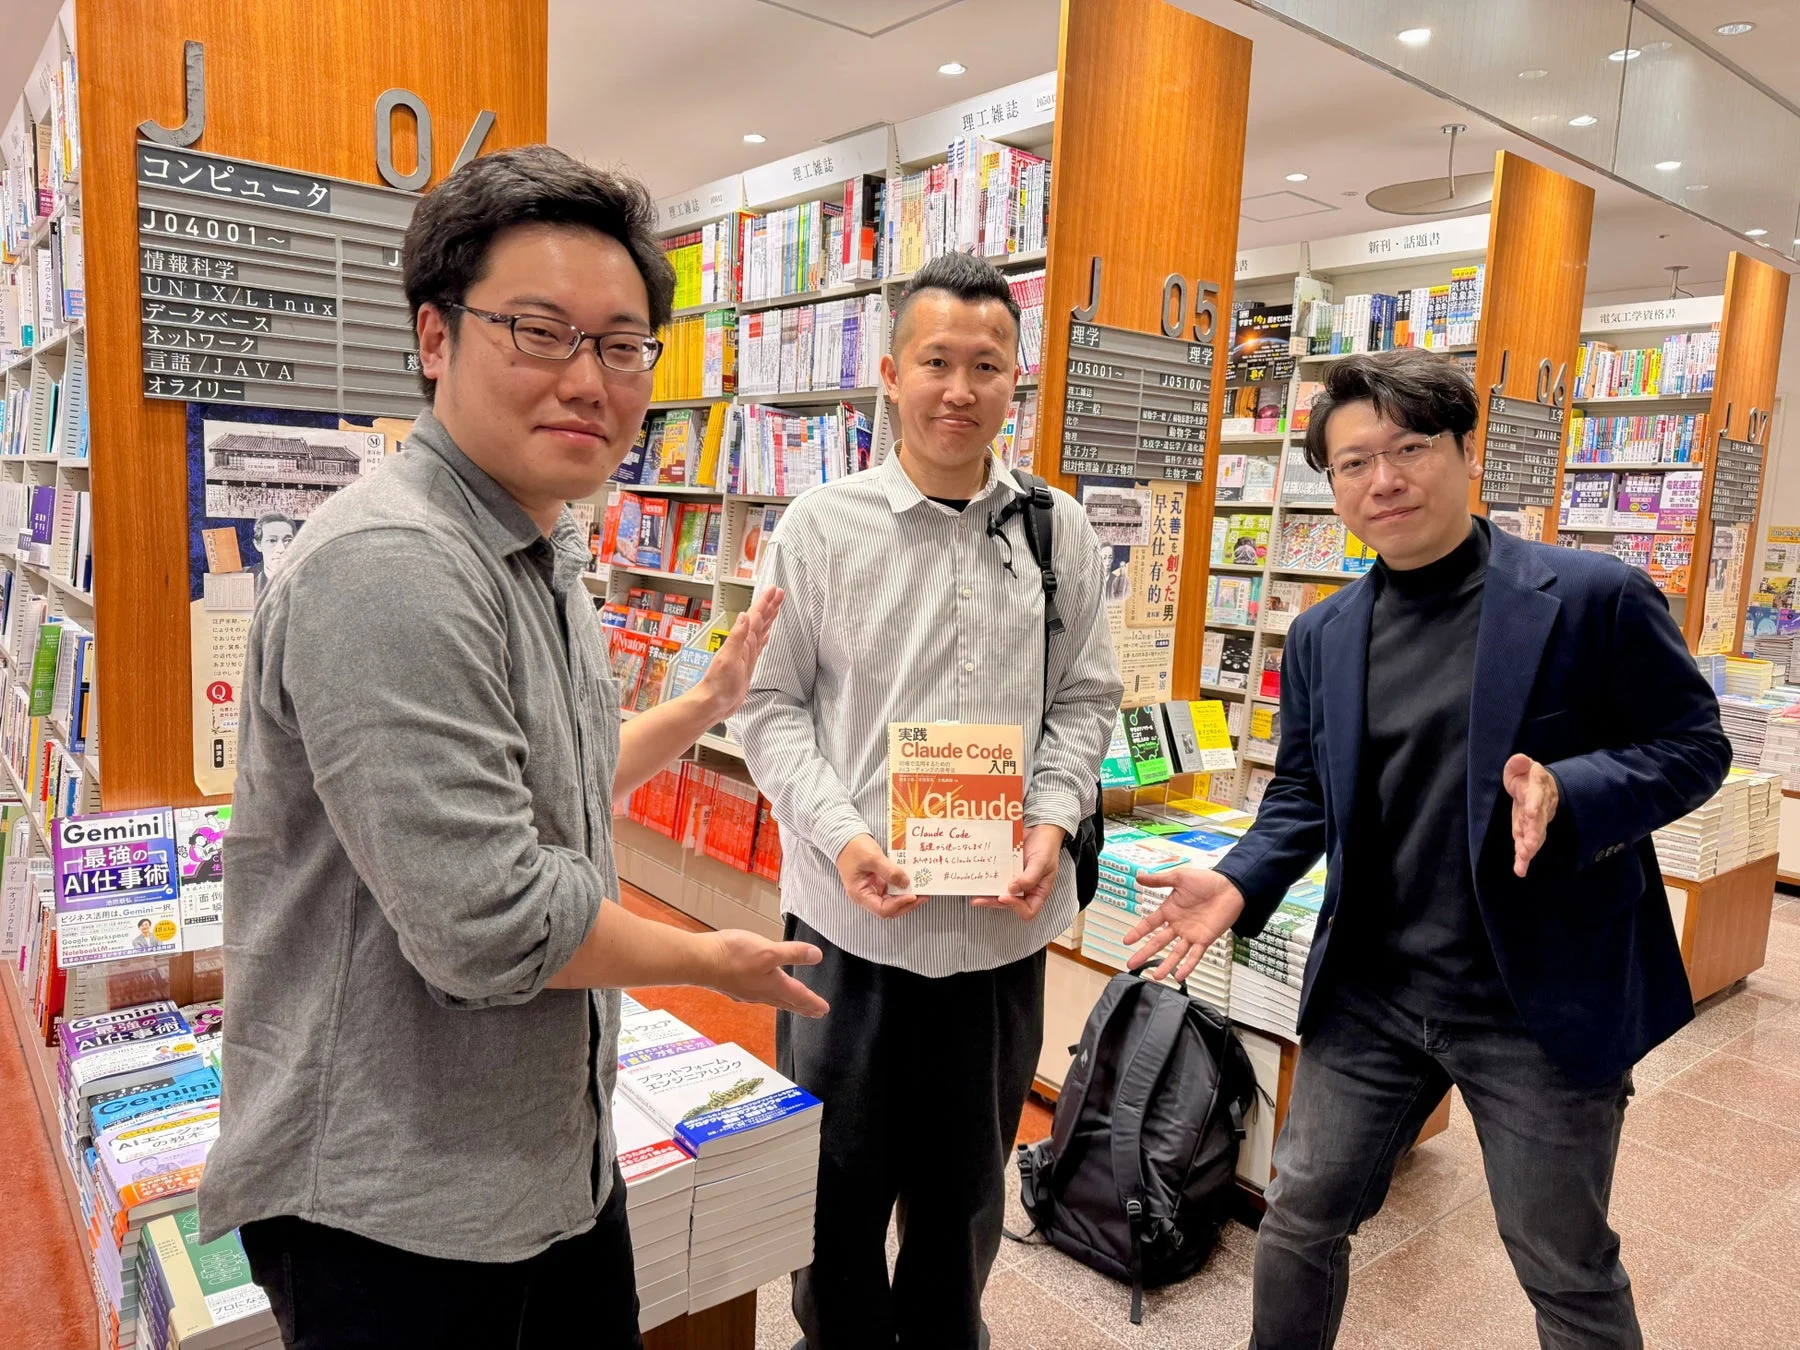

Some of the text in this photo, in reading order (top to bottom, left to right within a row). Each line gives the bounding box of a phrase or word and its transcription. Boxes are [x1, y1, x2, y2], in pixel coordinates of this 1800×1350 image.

[137, 41, 205, 147] J
[962, 98, 1020, 132] 理工雑誌
[143, 154, 329, 207] コンピュータ
[793, 155, 834, 182] 理工雑誌
[668, 198, 701, 219] 理工雑誌
[1368, 232, 1441, 254] 新刊・話題書
[144, 250, 236, 279] 情報科学
[145, 276, 334, 316] UNIX/Linux
[1071, 256, 1220, 344] J 05
[145, 303, 271, 333] データベース
[1600, 308, 1676, 324] 電気工学資格書
[146, 327, 256, 353] ネットワーク
[1072, 325, 1213, 366] 理学 理学
[148, 376, 243, 399] オライリー
[1067, 386, 1094, 398] 理工雑誌
[1537, 358, 1567, 407] 06
[1066, 400, 1101, 415] 科学一般
[1491, 398, 1564, 422] 工学 工学
[1066, 416, 1079, 426] 化学
[1748, 407, 1768, 444] 07
[1065, 431, 1078, 441] 物理
[1064, 445, 1098, 458] 量子力学
[1165, 467, 1203, 481] 生物学一般
[1148, 494, 1168, 604] 早矢仕有的
[681, 650, 709, 666] 現代数学
[211, 684, 227, 701] Q
[898, 727, 928, 742] 実践
[901, 742, 1013, 760] Claude Code
[988, 760, 1017, 775] 入門
[923, 791, 1024, 821] Claude
[63, 815, 160, 845] Gemini
[912, 826, 971, 839] Claude Code
[83, 844, 148, 870] 最強の
[64, 863, 171, 896] AI仕事術
[62, 931, 130, 946] Google Workspace
[62, 945, 108, 957] NotebookLM
[72, 1003, 165, 1029] Gemini
[95, 1017, 157, 1036] 最強の
[79, 1020, 182, 1052] AI仕事術
[637, 1058, 729, 1086] プラットフォーム
[648, 1060, 742, 1091] エンジニアリング
[99, 1079, 218, 1115] Gemini
